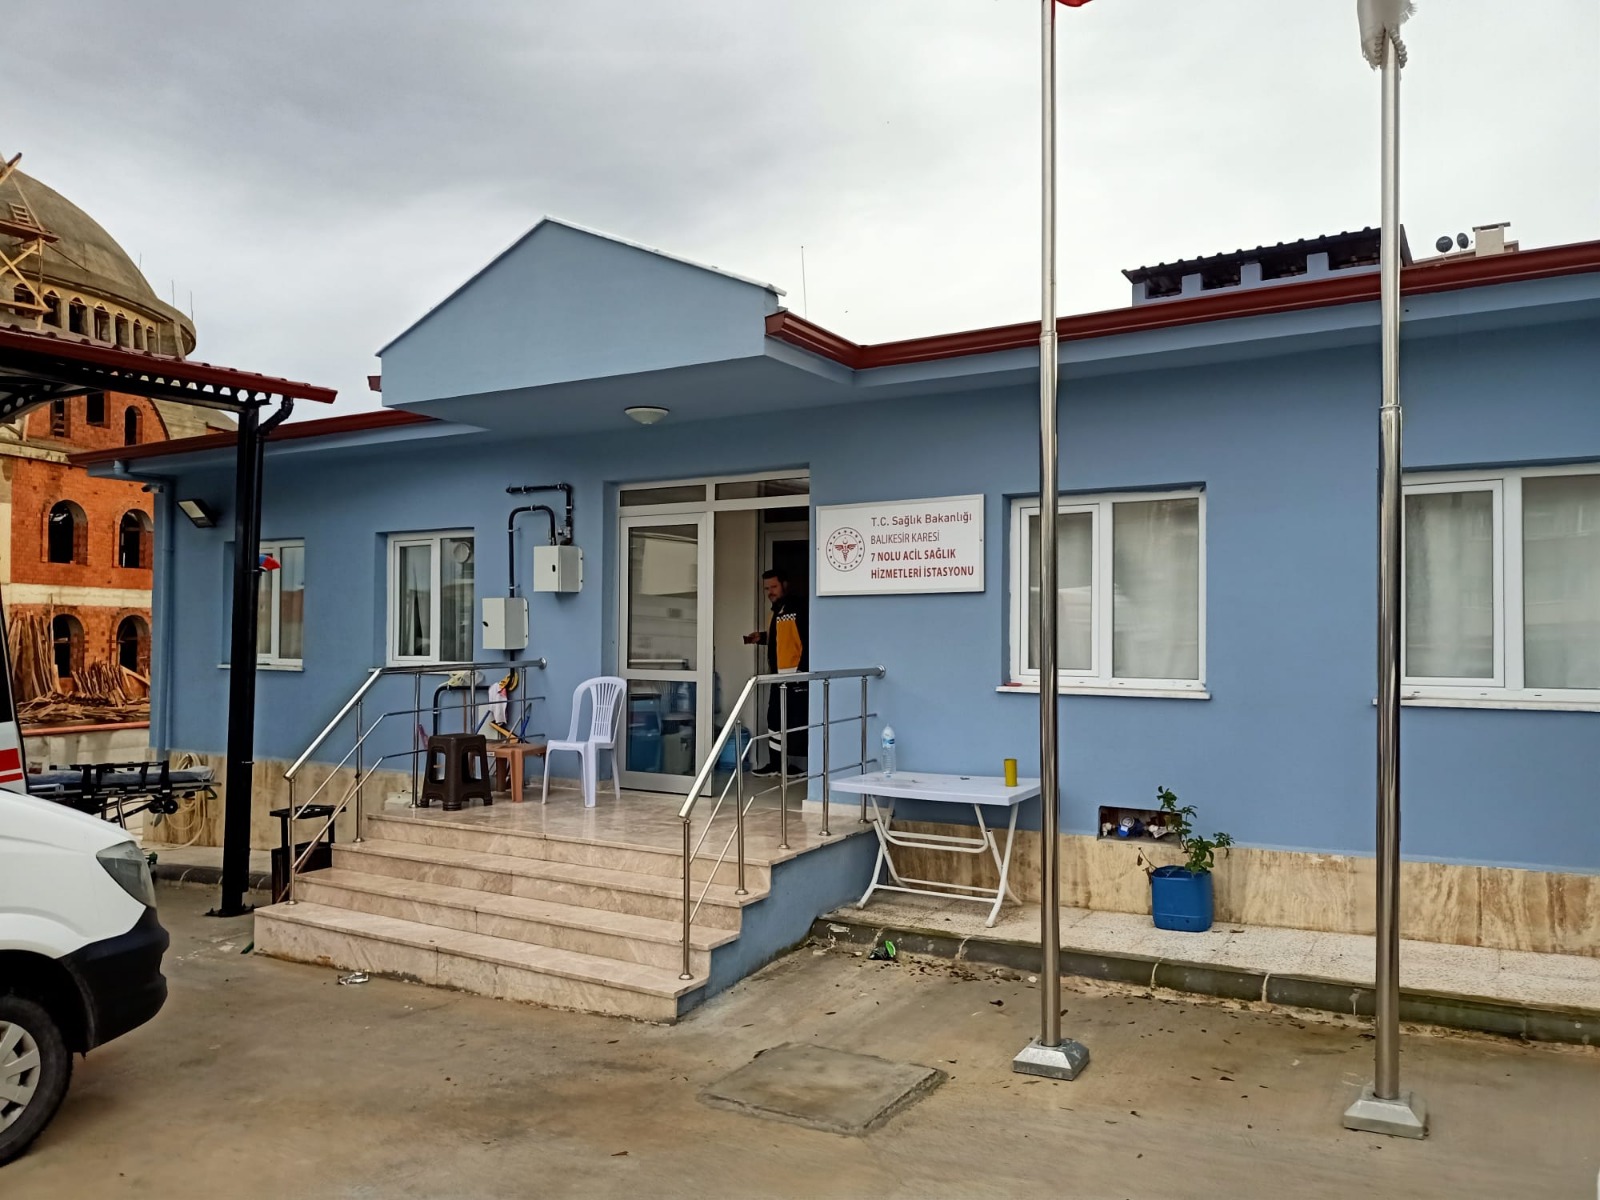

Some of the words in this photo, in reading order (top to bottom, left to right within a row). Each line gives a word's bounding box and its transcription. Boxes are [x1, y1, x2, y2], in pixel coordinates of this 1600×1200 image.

[871, 517, 889, 527] T.C.
[892, 514, 922, 527] Sağlık
[925, 512, 972, 524] Bakanlığı
[871, 532, 910, 545] BALIKESİR
[911, 530, 939, 542] KARESİ
[871, 552, 876, 562] 7
[877, 551, 901, 562] NOLU
[903, 548, 922, 560] ACİL
[924, 548, 956, 560] SAĞLIK
[871, 565, 922, 579] HİZMETLERİ
[924, 565, 974, 578] İSTASYONU
